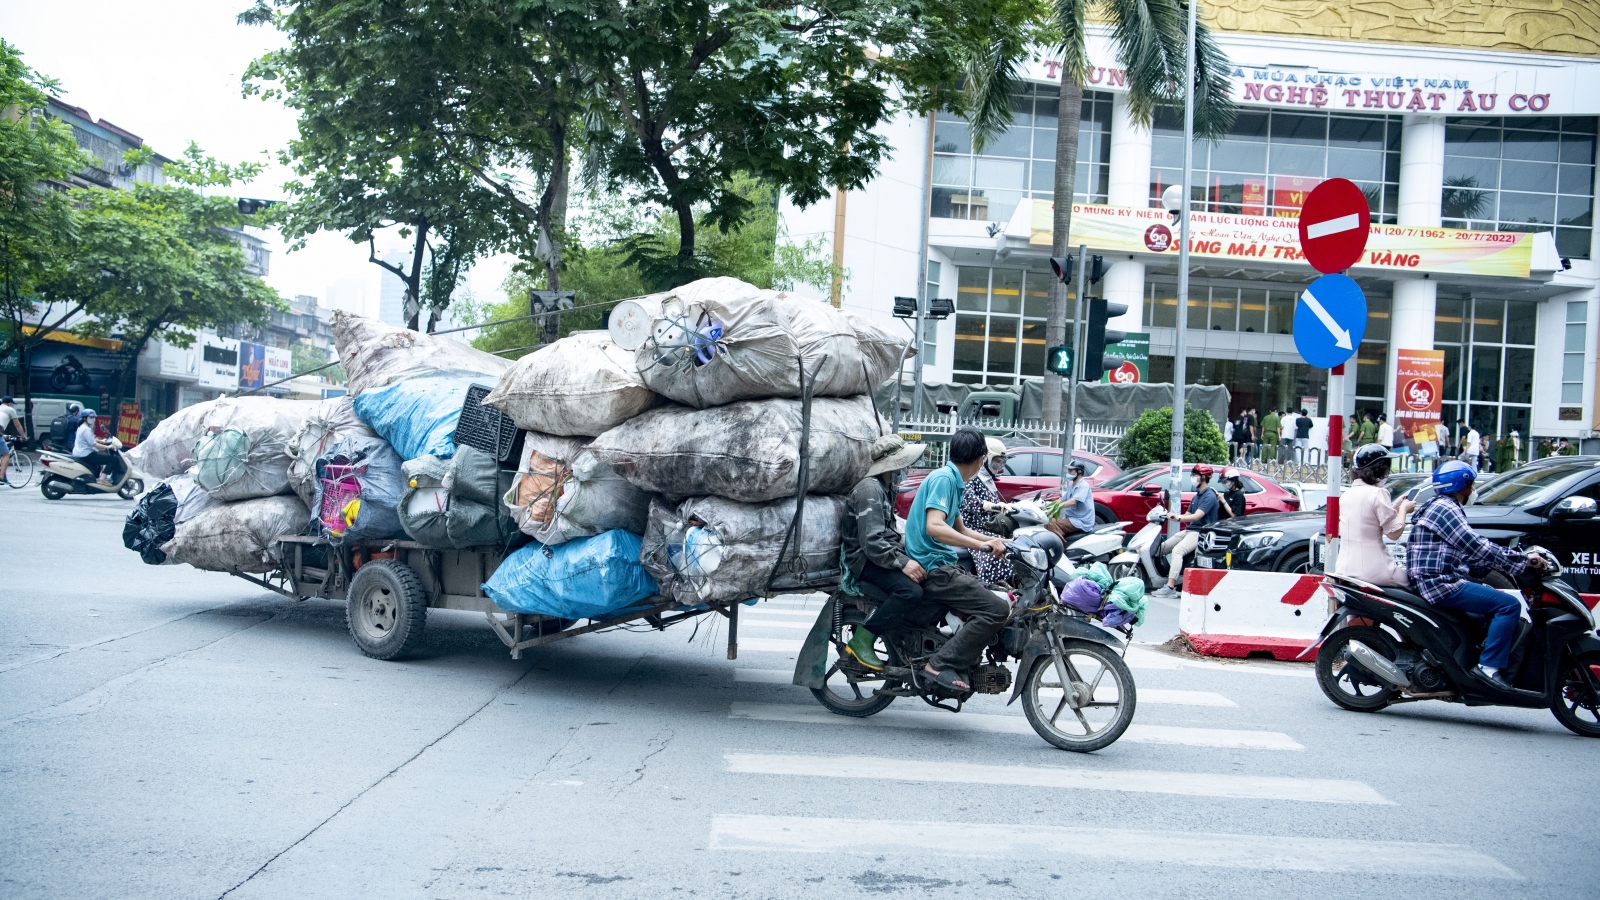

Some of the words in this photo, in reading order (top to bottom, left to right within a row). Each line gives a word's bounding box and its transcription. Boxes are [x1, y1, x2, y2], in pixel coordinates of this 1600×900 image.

[1254, 70, 1298, 83] MÚA
[1305, 74, 1362, 88] NHẠC
[1371, 76, 1418, 90] VIỆT
[1424, 78, 1470, 90] NAM
[1244, 82, 1329, 109] NGHỆ
[1342, 87, 1447, 113] THUẬT
[1457, 89, 1498, 112] ÂU
[1508, 93, 1551, 112] CƠ
[1210, 214, 1231, 225] LỰC
[1234, 216, 1269, 228] LƯỢNG
[1385, 226, 1445, 239] (20/7/1962
[1455, 231, 1516, 244] 20/7/2022)
[1227, 240, 1267, 257] MÃI
[1370, 249, 1421, 267] VÀNG
[1571, 552, 1590, 565] XE
[1570, 566, 1589, 575] THẤT
